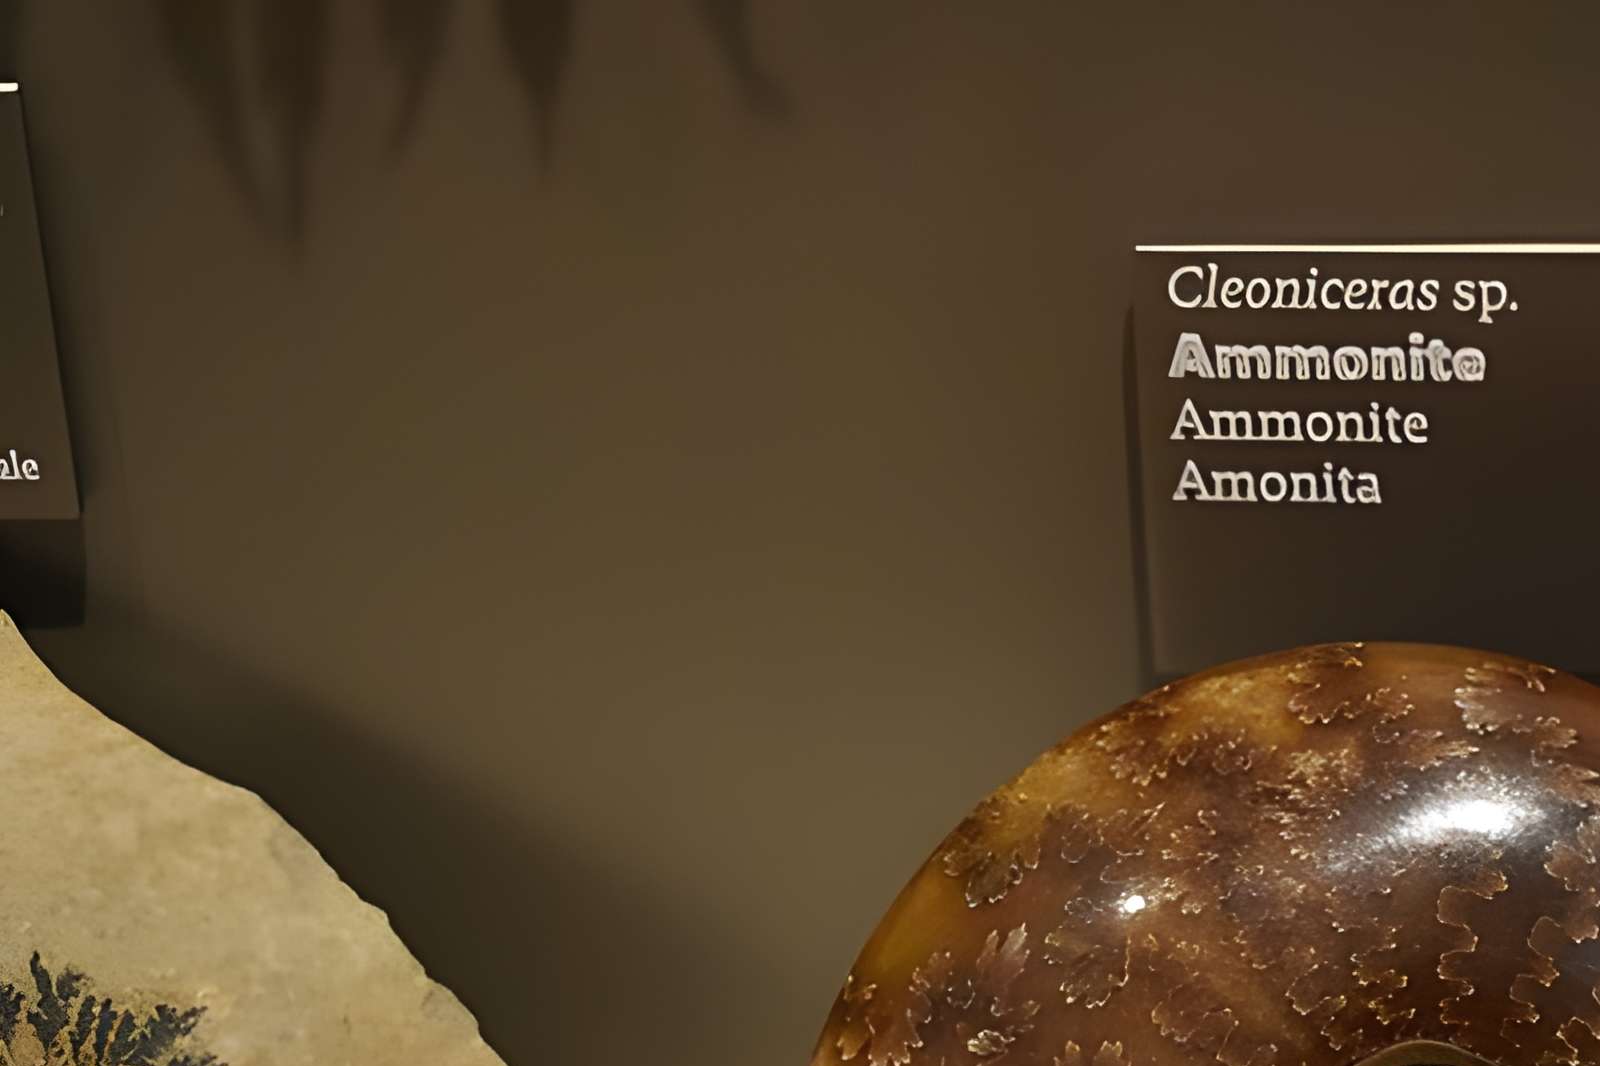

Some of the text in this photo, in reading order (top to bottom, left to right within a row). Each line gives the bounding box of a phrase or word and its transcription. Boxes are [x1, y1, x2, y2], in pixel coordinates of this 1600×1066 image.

[1168, 263, 1519, 323] Cleoniceras sp.
[1170, 398, 1429, 443] Ammonite
[1173, 459, 1382, 503] Amonita
